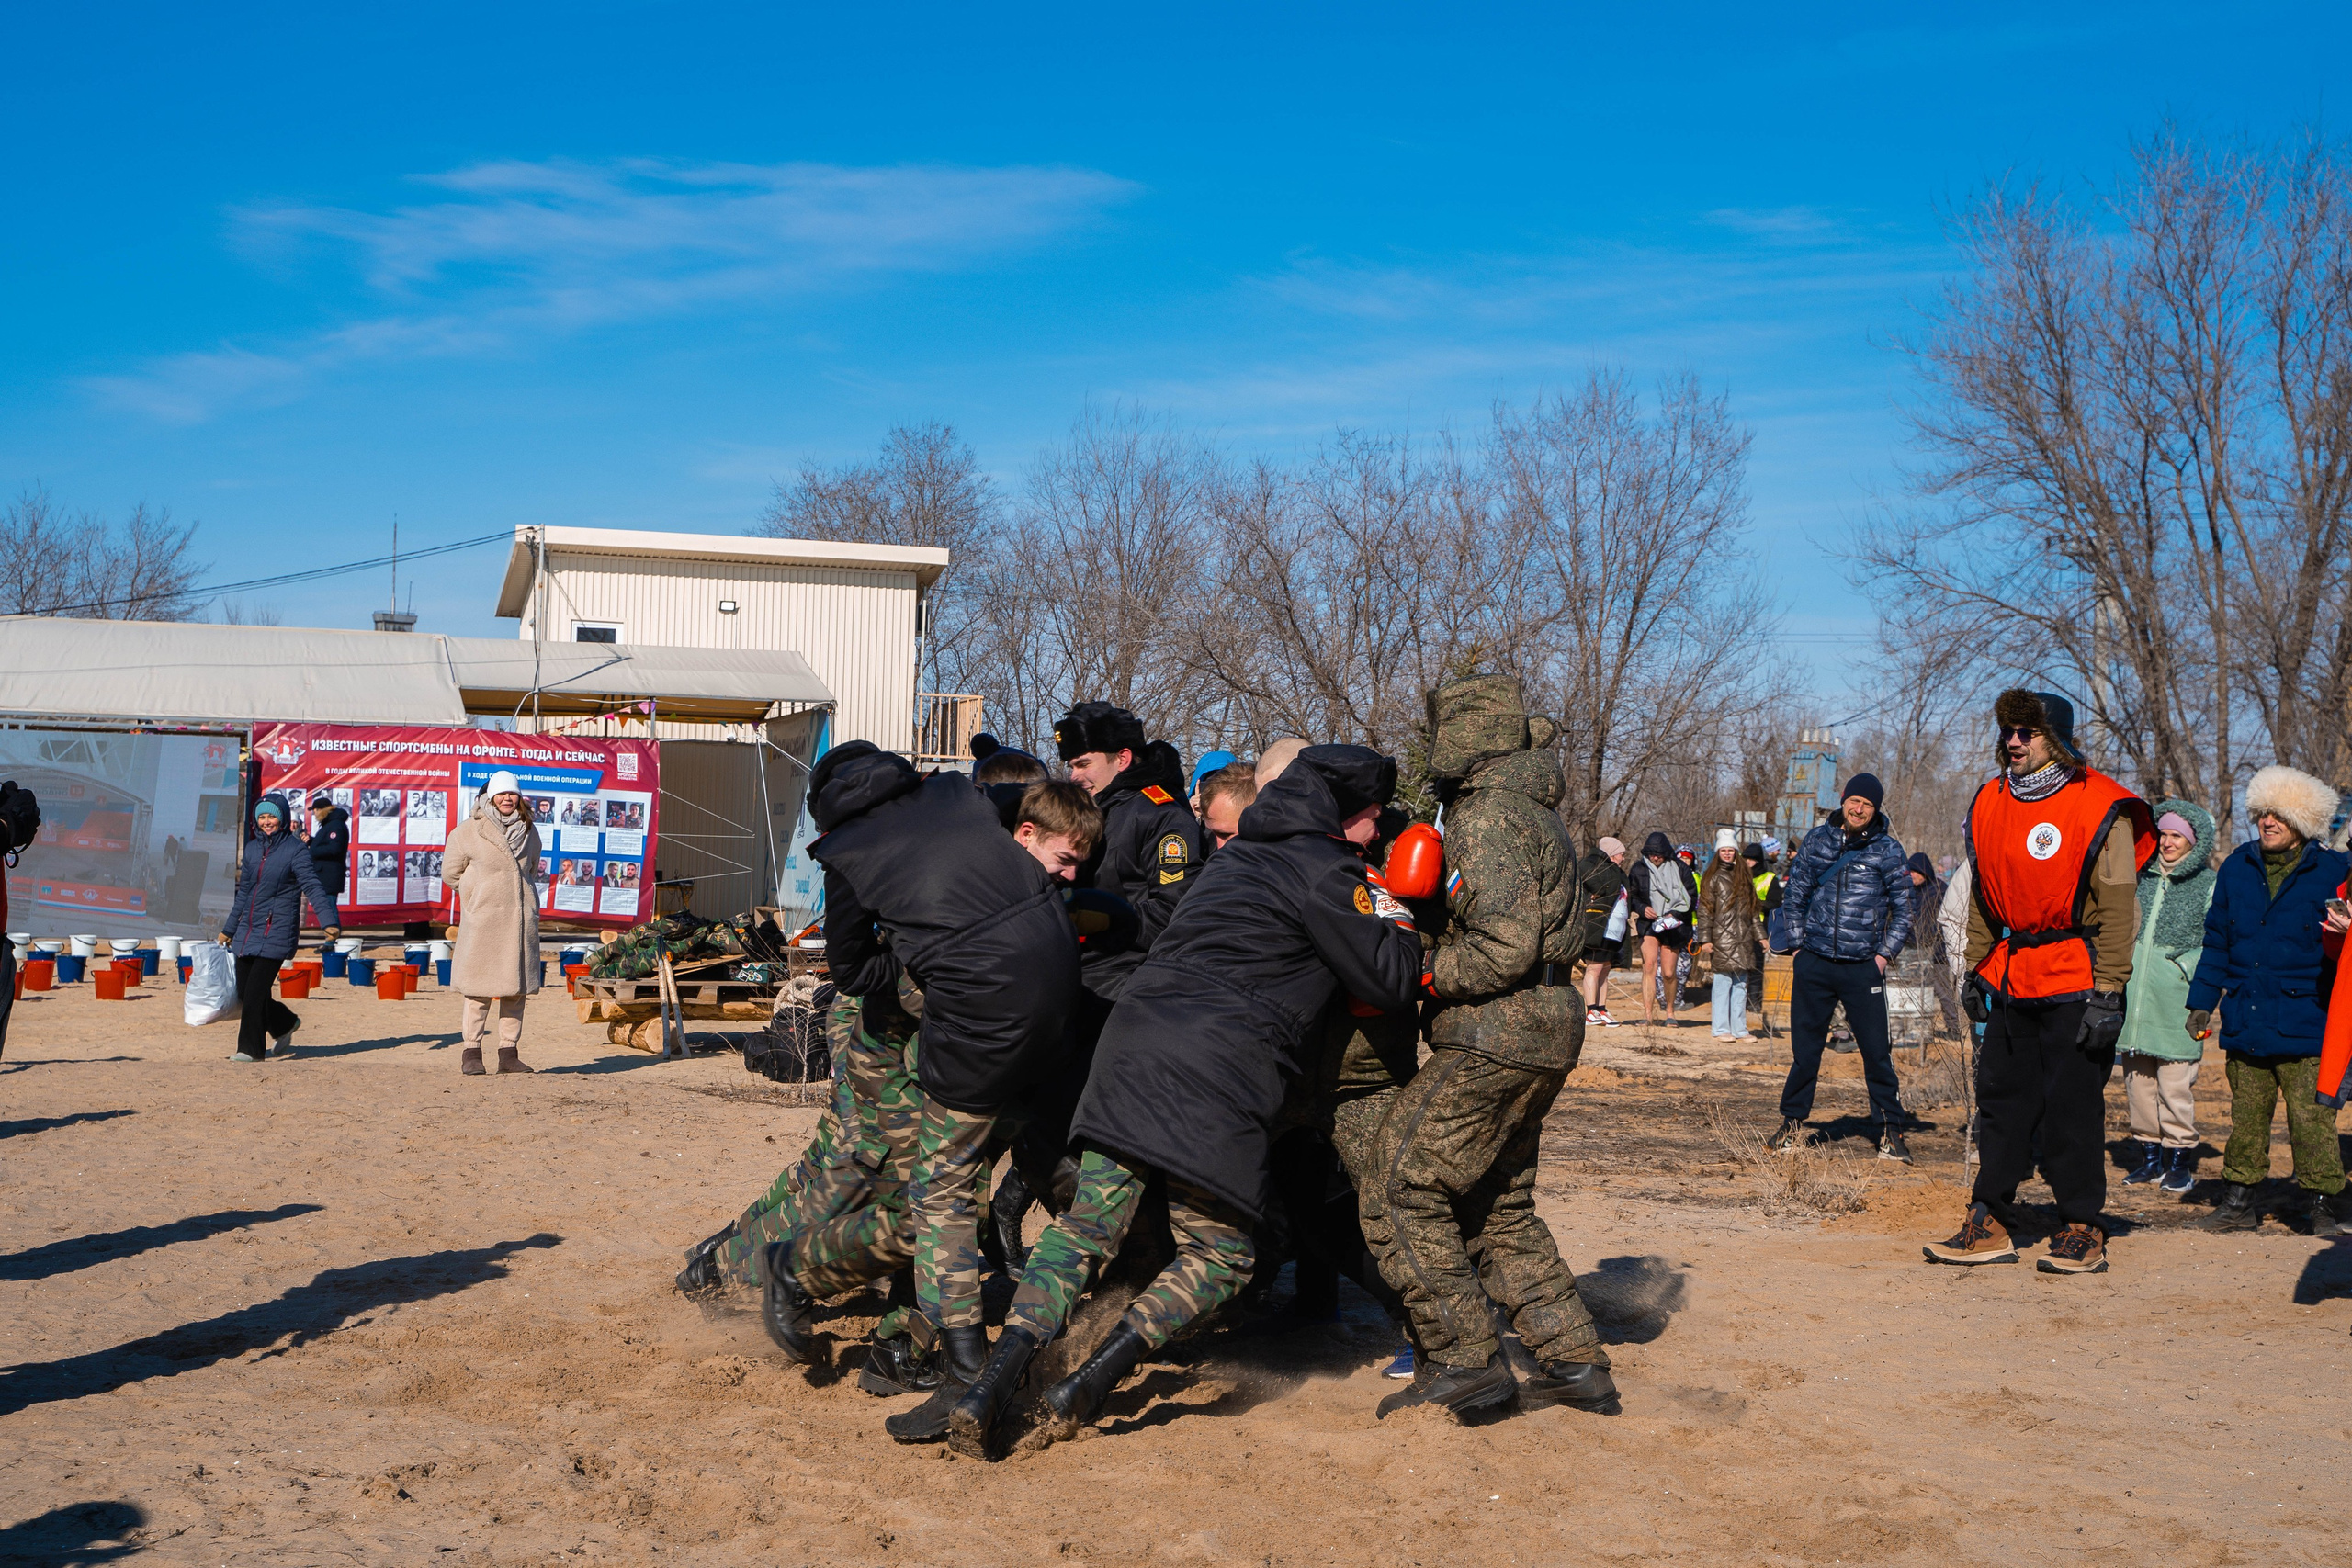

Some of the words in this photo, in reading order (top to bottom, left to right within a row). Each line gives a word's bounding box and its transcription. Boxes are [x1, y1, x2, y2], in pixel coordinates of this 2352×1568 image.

[311, 739, 377, 752] ИЗВЕСТНЫЕ
[379, 741, 454, 754] СПОРТСМЕНЫ
[456, 743, 470, 755] НА
[472, 744, 518, 759] ФРОНТЕ.
[520, 749, 553, 761] ТОГДА
[555, 750, 562, 761] И
[565, 750, 605, 763] СЕЙЧАС
[348, 767, 377, 775] ВЕЛИКОЙ
[378, 768, 427, 777] ОТЕЧЕСТВЕННОЙ
[428, 769, 450, 778] ВОЙНЫ
[472, 772, 488, 780] ХОДЕ
[533, 773, 560, 784] ВОЕННОЙ
[561, 775, 592, 785] ОПЕРАЦИИ
